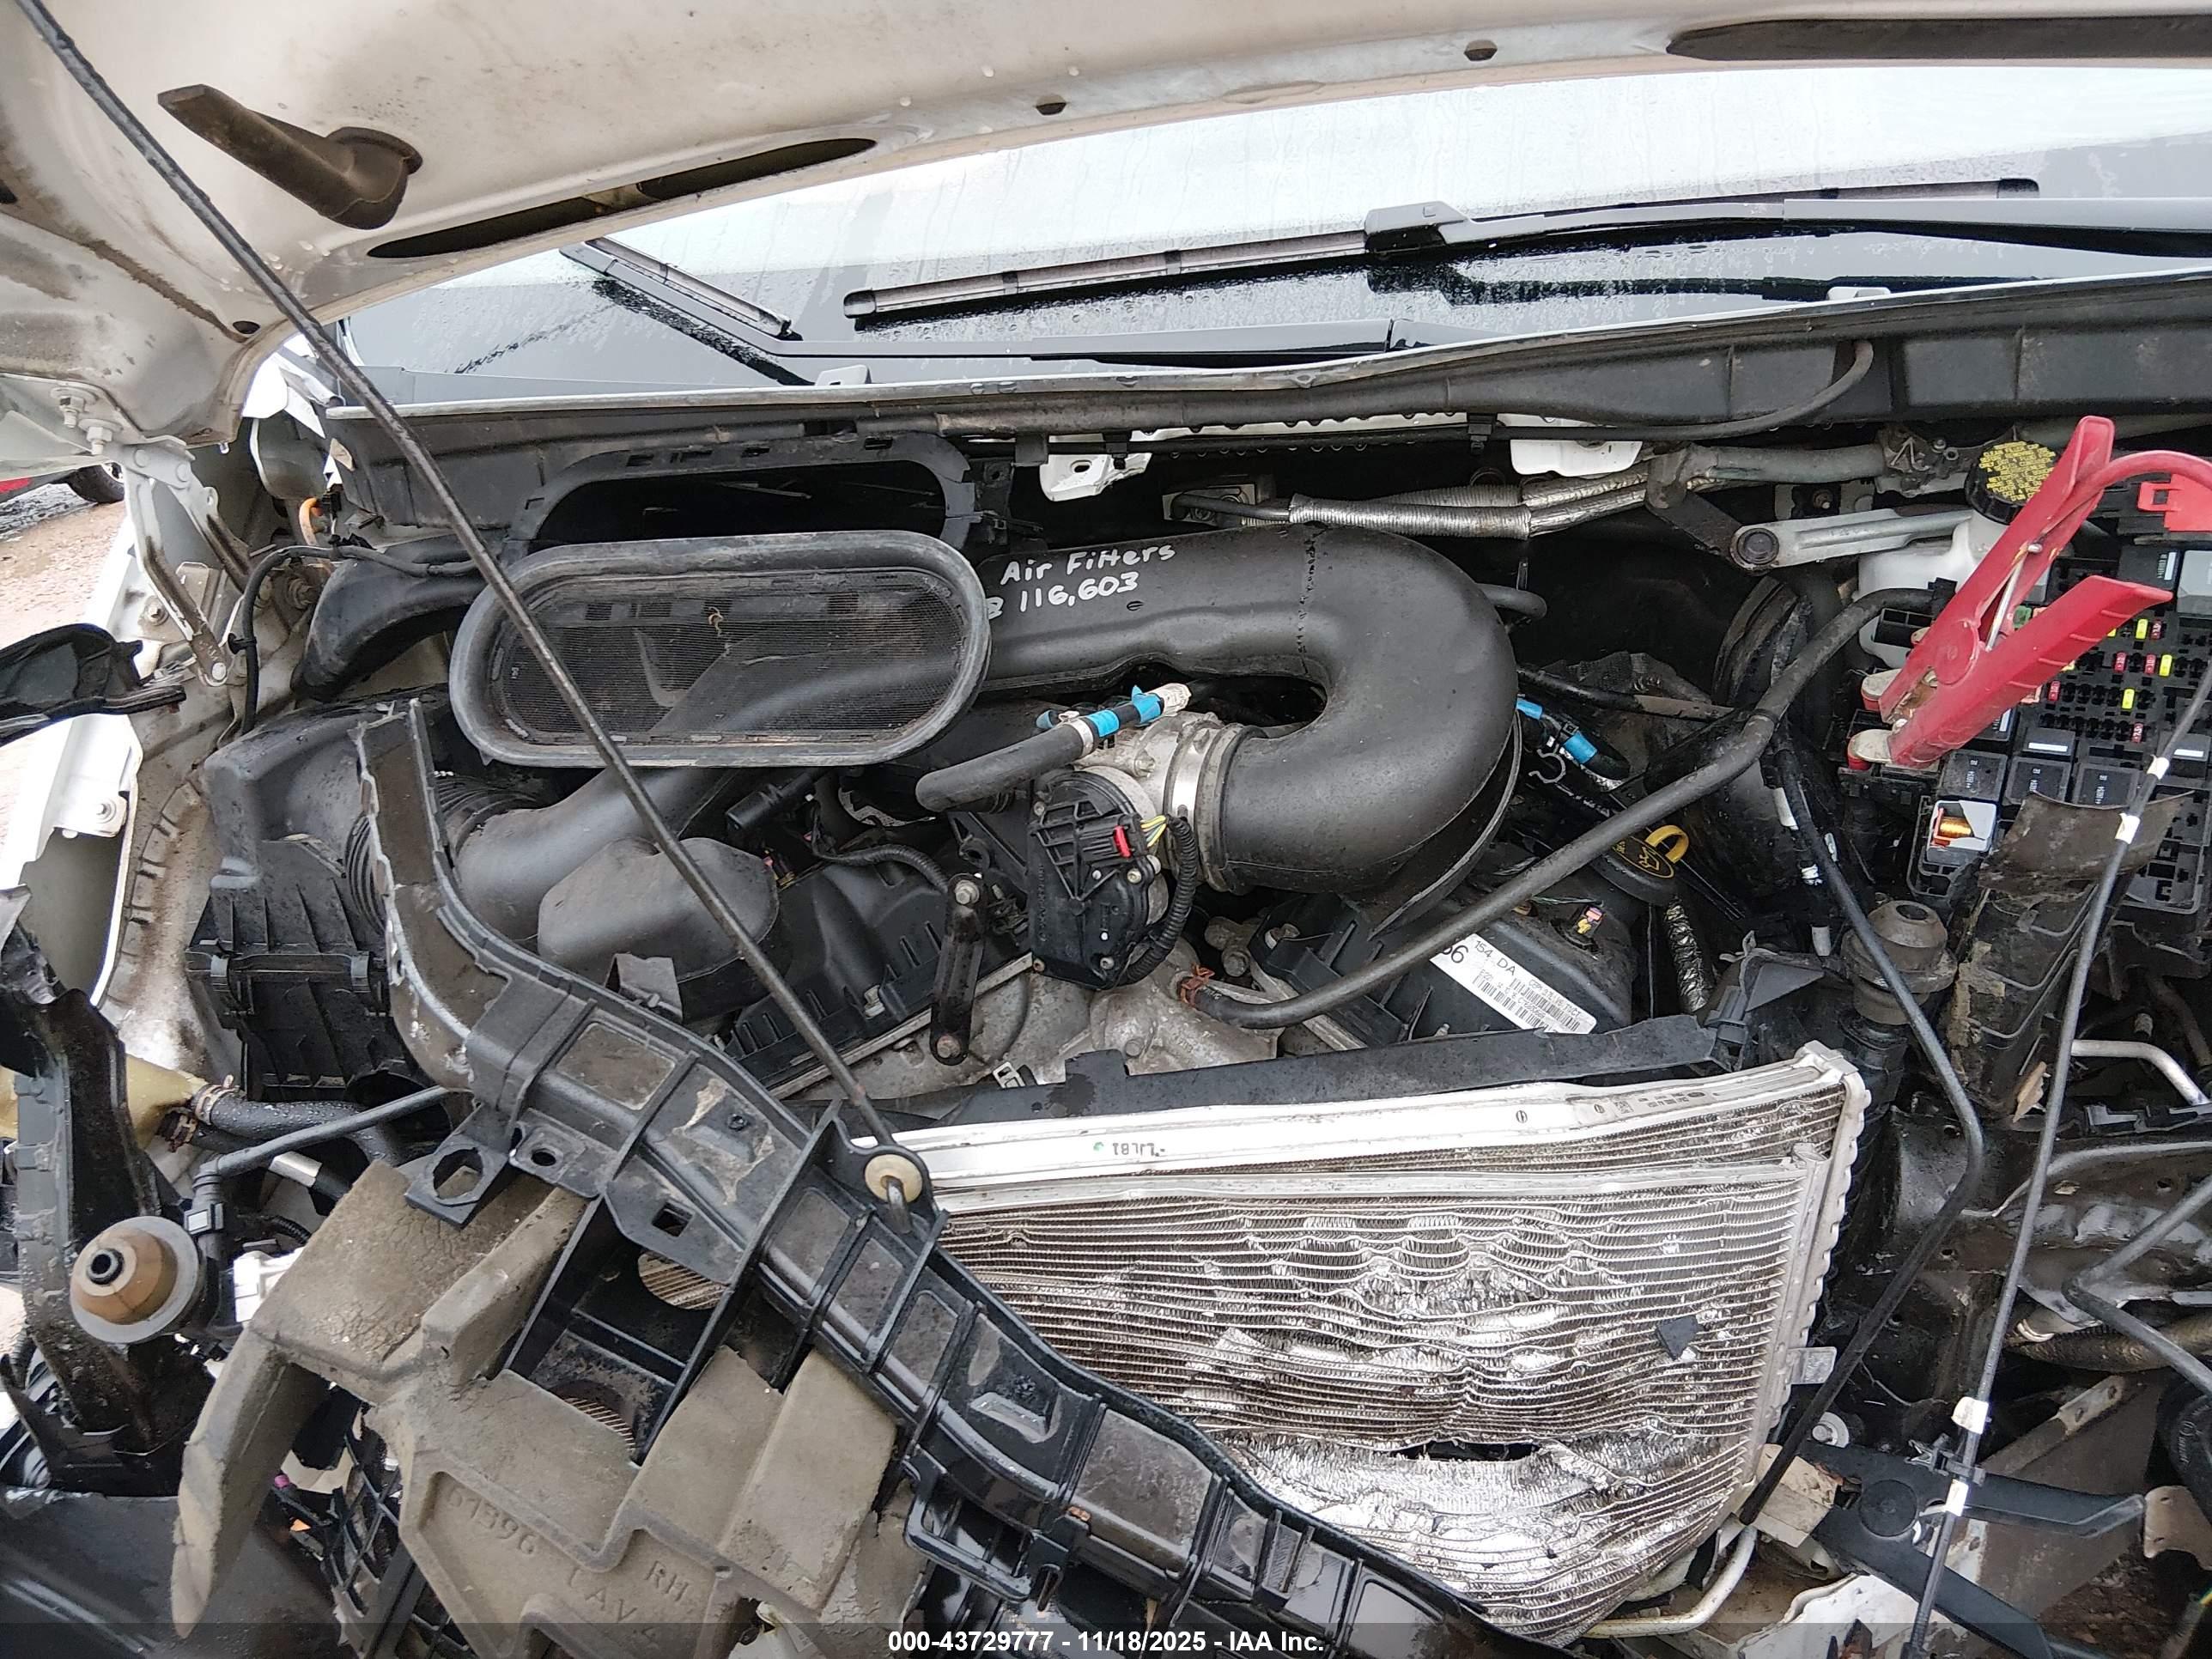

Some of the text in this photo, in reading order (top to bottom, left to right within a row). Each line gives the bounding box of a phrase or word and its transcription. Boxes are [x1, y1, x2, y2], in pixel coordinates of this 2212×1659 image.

[1000, 544, 1176, 586] Air Filters
[1020, 571, 1139, 612] 116,603
[1474, 940, 1516, 976] 154 DA
[644, 1560, 690, 1601] RH
